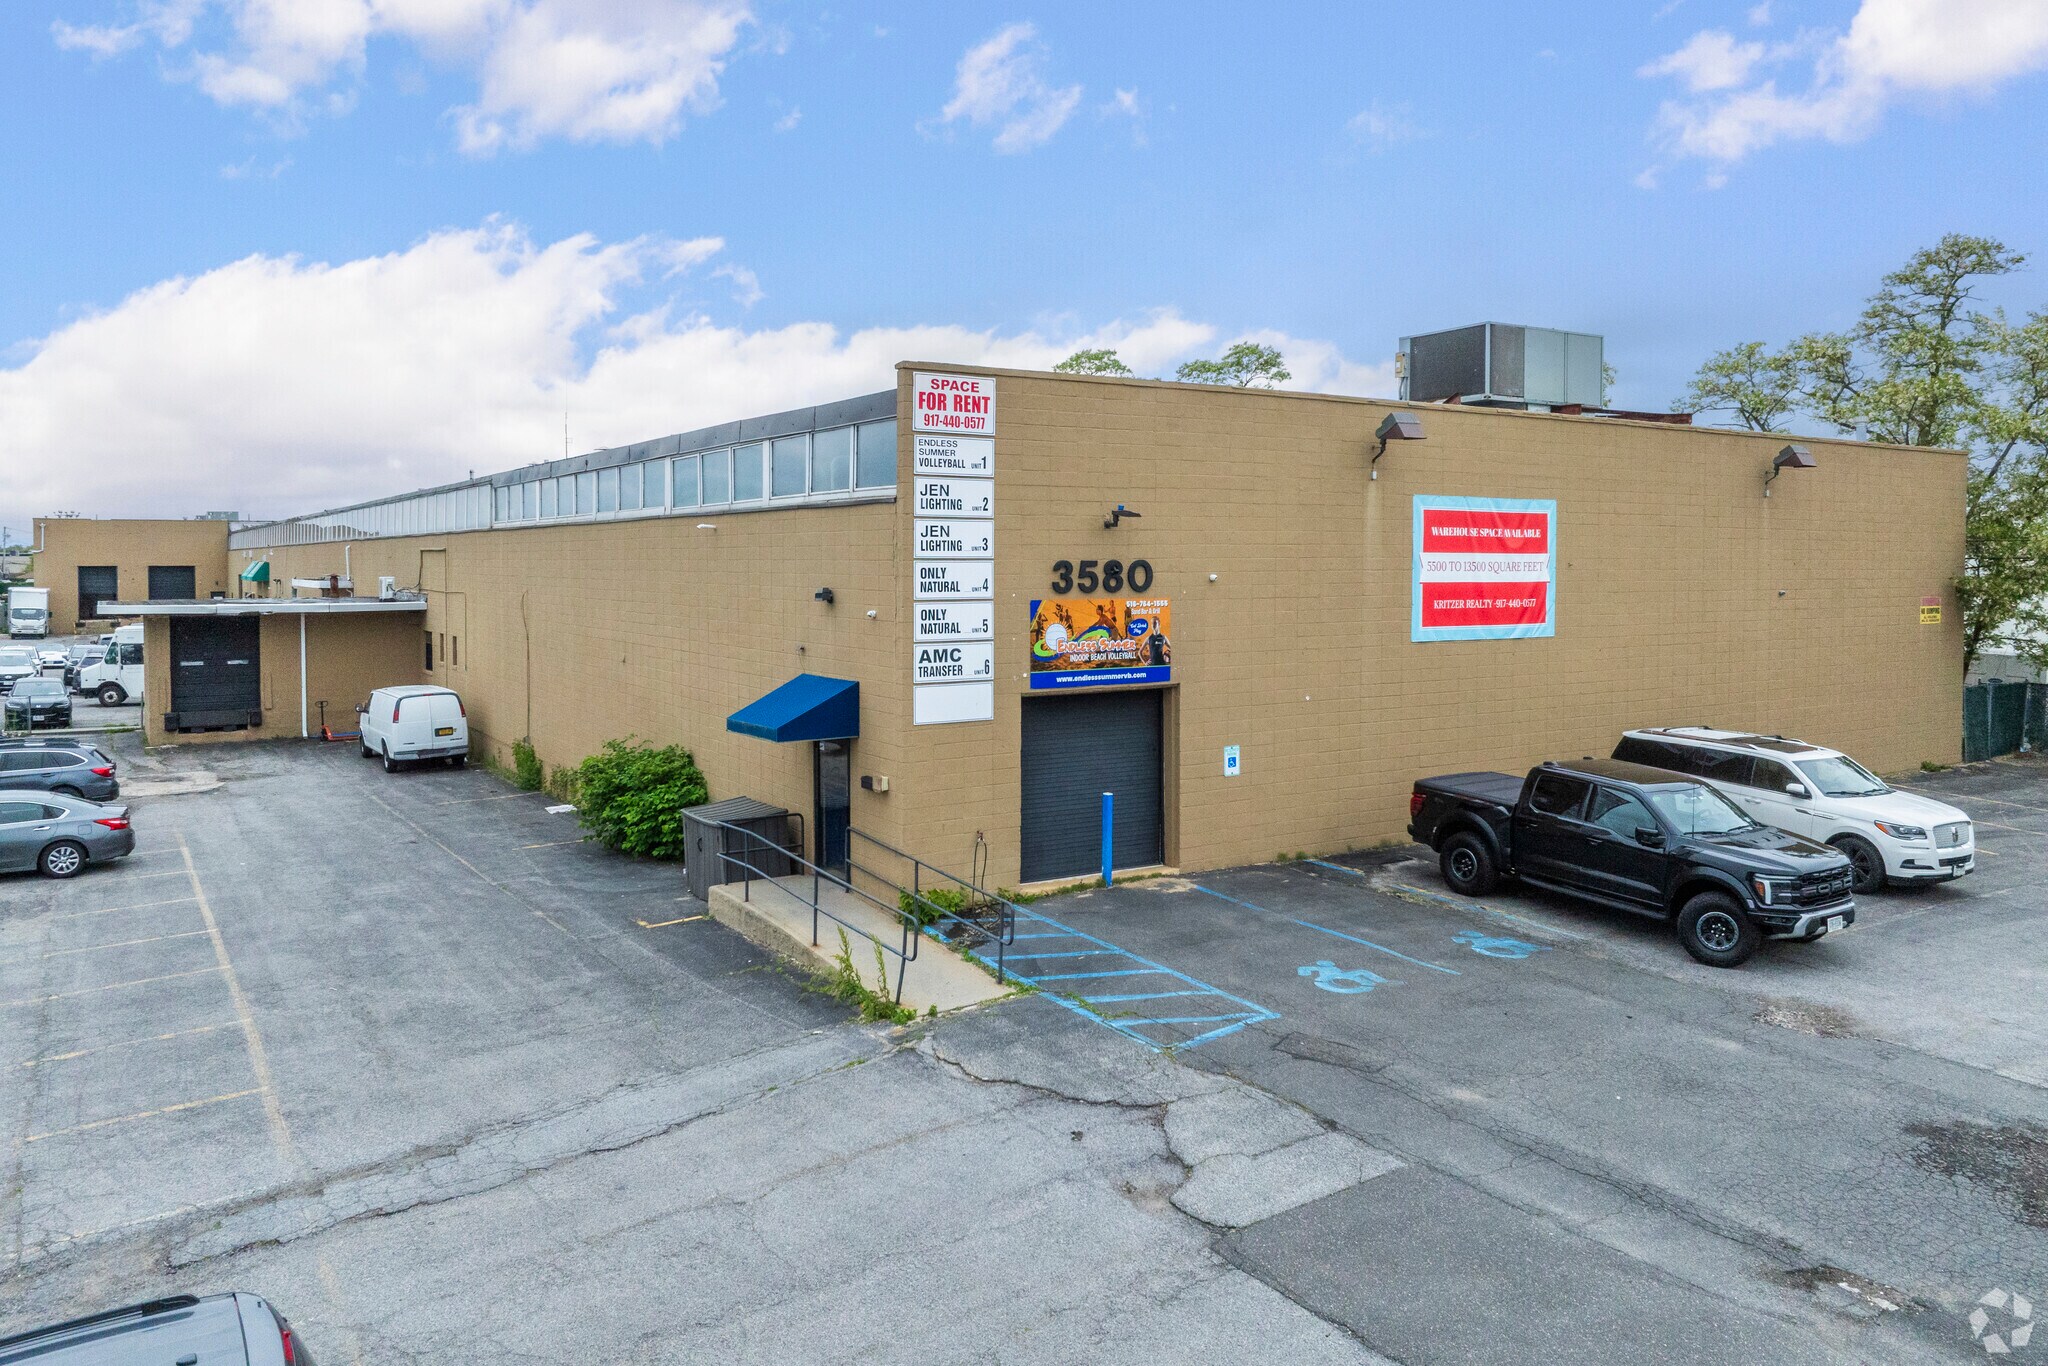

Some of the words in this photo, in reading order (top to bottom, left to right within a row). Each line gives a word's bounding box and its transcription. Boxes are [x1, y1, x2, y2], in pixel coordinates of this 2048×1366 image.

[930, 378, 980, 393] SPACE
[918, 391, 947, 411] FOR
[953, 394, 991, 414] RENT
[923, 413, 986, 430] 917-440-0577
[918, 438, 958, 448] ENDLESS
[918, 447, 956, 457] SUMMER
[918, 457, 966, 469] VOLLEYBALL
[981, 456, 987, 469] 1
[920, 484, 950, 496] JEN
[920, 498, 962, 511] LIGHTING
[982, 497, 989, 512] 2
[920, 525, 950, 538] JEN
[1431, 526, 1479, 537] WAREHOUSE
[1479, 527, 1503, 538] SPACE
[1504, 528, 1541, 538] AVAILABLE
[920, 540, 963, 552] LIGHTING
[982, 537, 989, 552] 3
[920, 567, 947, 580] ONLY
[1426, 560, 1447, 572] 5500
[1449, 560, 1461, 572] TO
[1463, 560, 1486, 572] 13500
[1487, 560, 1522, 574] SQUARE
[1523, 561, 1544, 572] FEET
[1051, 559, 1154, 594] 3580
[920, 581, 961, 593] NATURAL
[982, 578, 989, 592] 4
[1433, 599, 1465, 609] KRITZER
[1466, 599, 1492, 608] REALTY
[920, 609, 947, 621] ONLY
[920, 622, 961, 635] NATURAL
[982, 618, 989, 633] 5
[918, 648, 962, 664] AMC
[1070, 653, 1090, 662] INDOOR
[1090, 653, 1107, 661] BEACH
[1107, 652, 1136, 660] VOLLEYBALL
[918, 664, 963, 678] TRANSFER
[984, 659, 990, 675] 6
[1056, 672, 1147, 683] www.endlesssummervb.com
